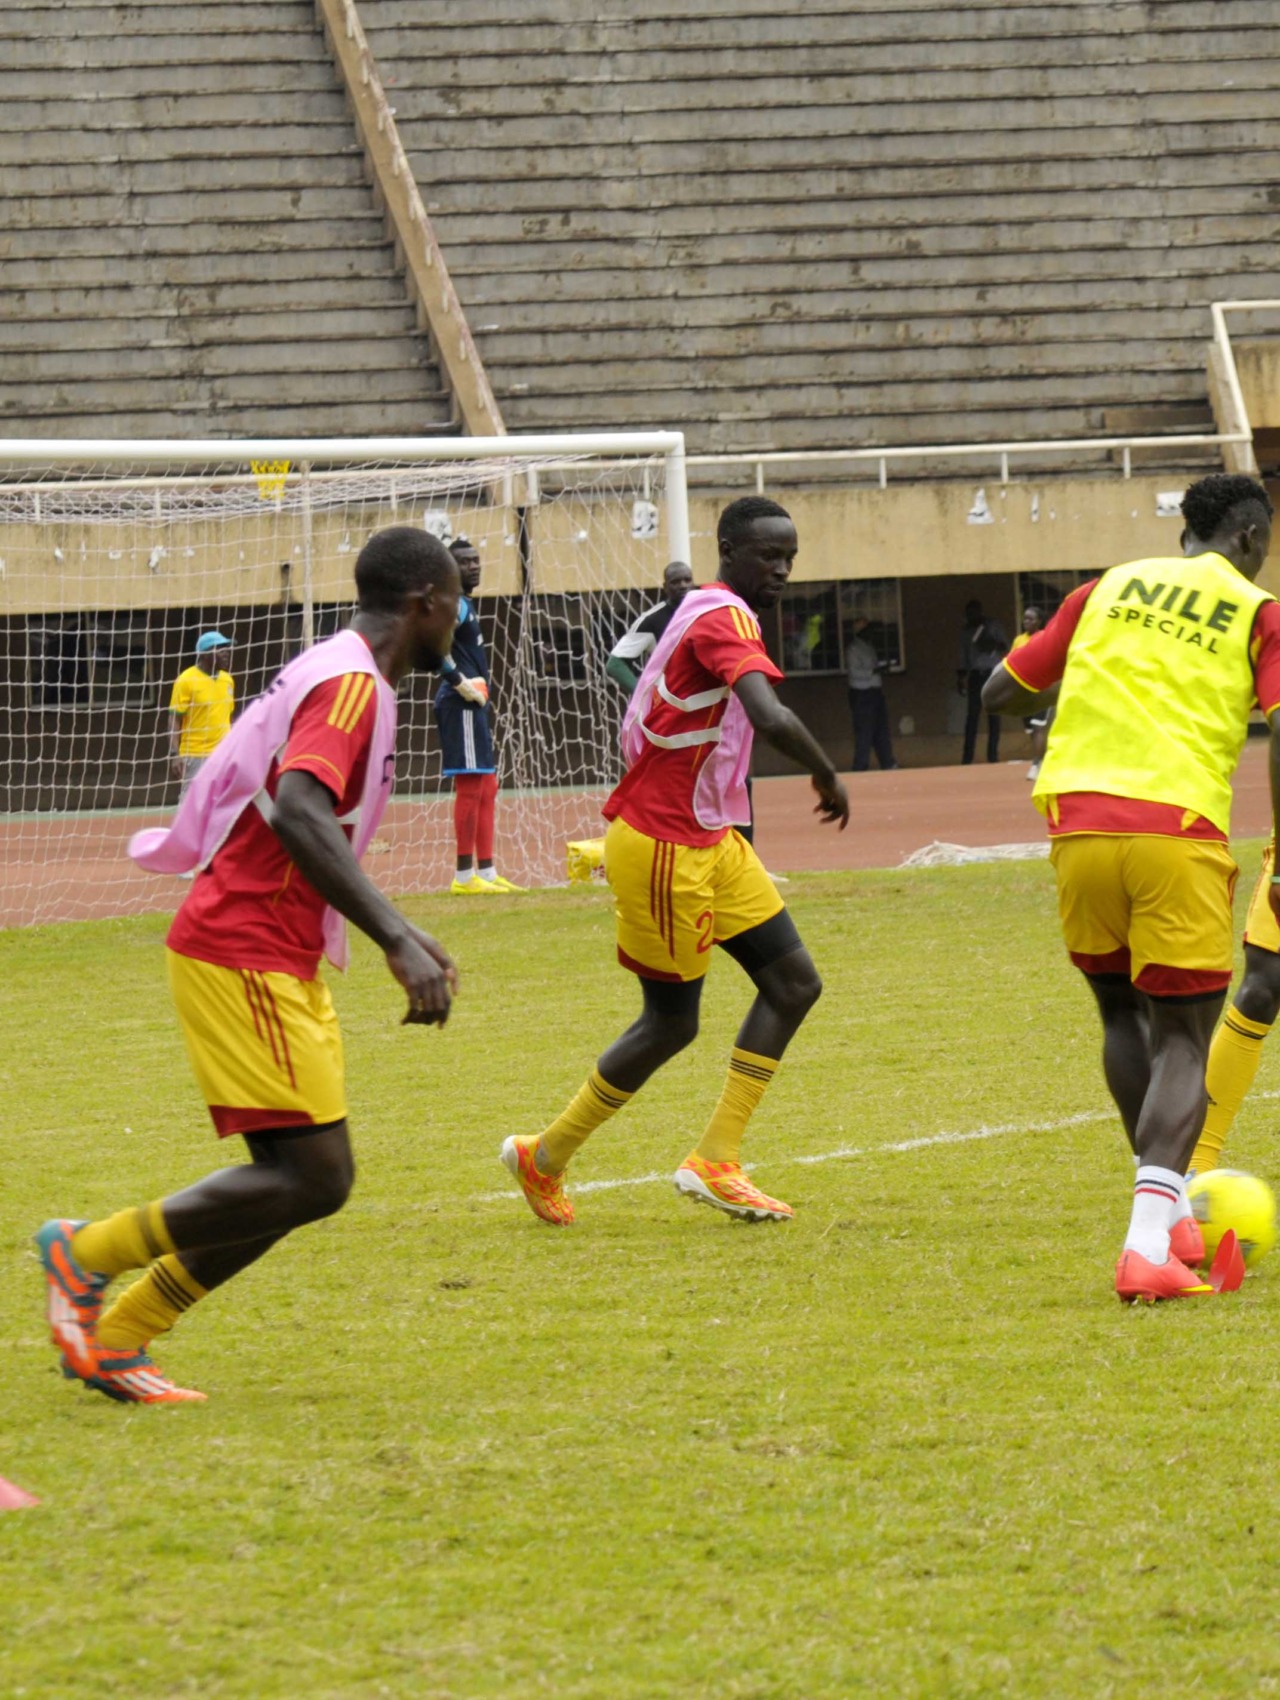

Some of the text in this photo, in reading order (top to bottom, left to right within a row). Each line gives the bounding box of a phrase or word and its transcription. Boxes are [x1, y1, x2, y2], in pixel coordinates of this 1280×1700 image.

[1119, 577, 1240, 634] NILE
[1106, 606, 1219, 654] SPECIAL
[695, 910, 714, 955] 2
